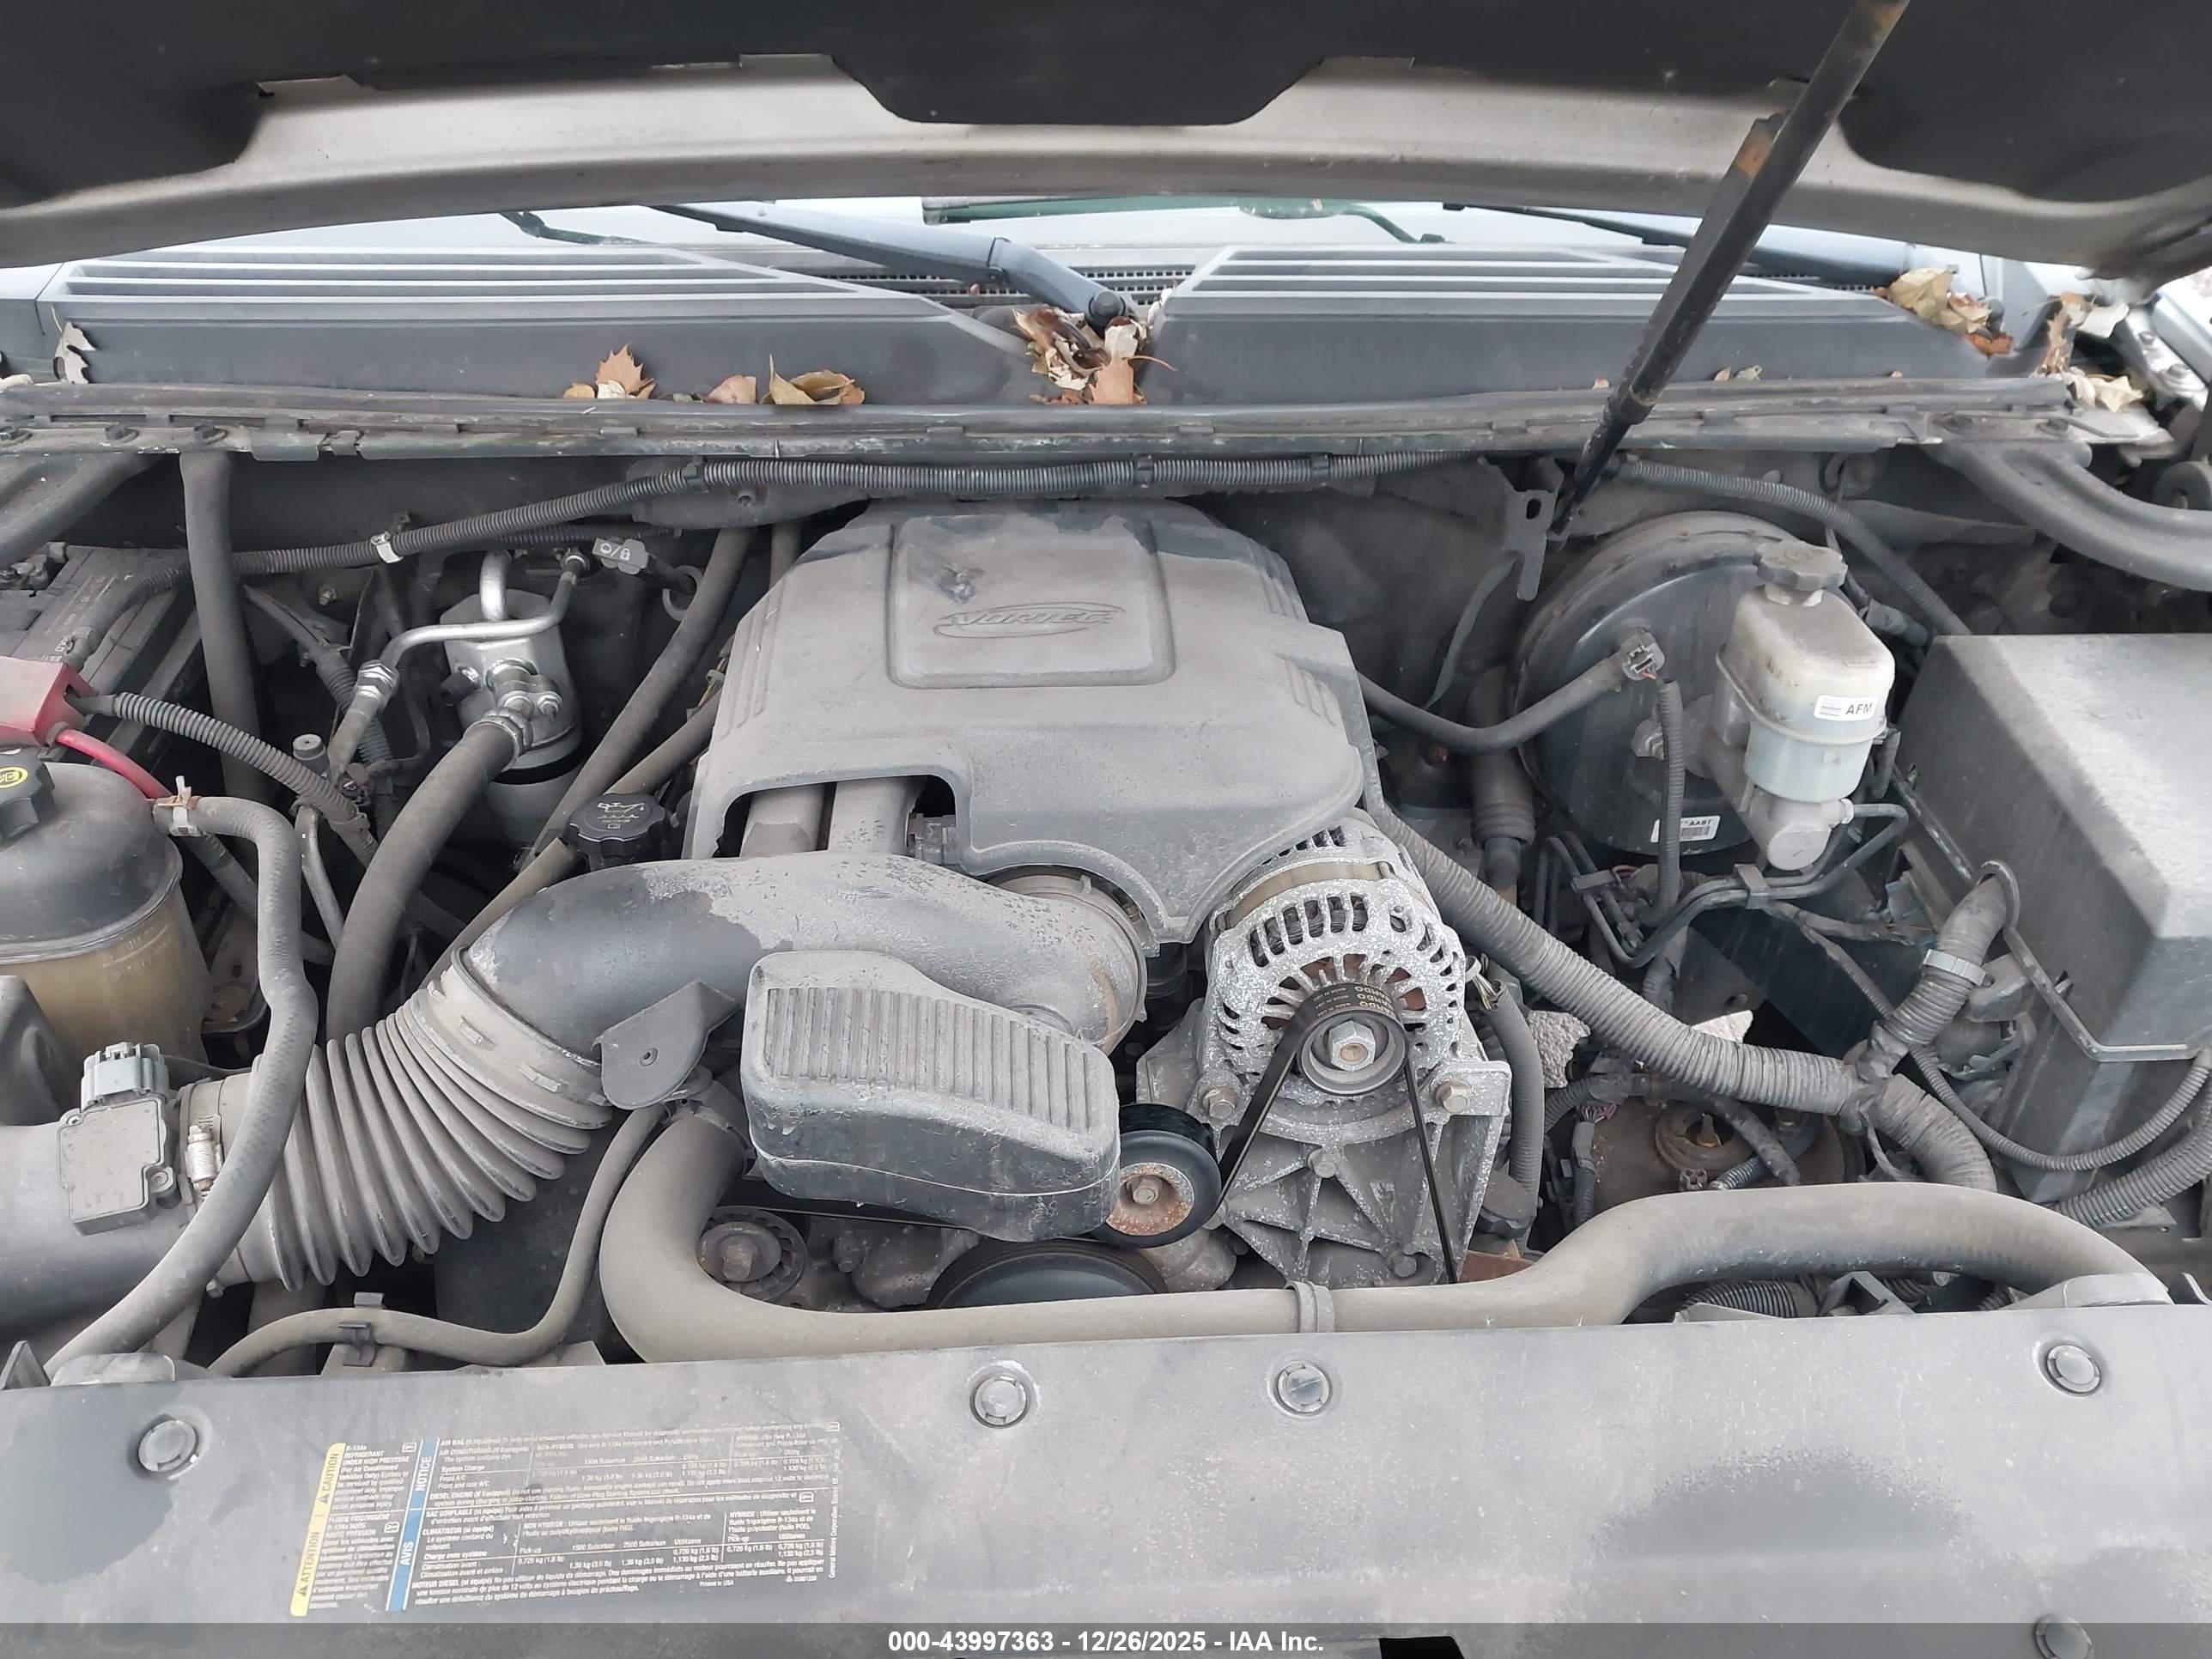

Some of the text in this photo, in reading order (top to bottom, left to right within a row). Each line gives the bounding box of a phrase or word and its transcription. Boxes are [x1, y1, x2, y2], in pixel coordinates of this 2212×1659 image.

[1845, 702, 1873, 715] AFM
[323, 1452, 339, 1492] CAUTION
[416, 1456, 432, 1492] NOTICE
[304, 1531, 320, 1584] ATTENTION
[400, 1540, 415, 1566] AVIS
